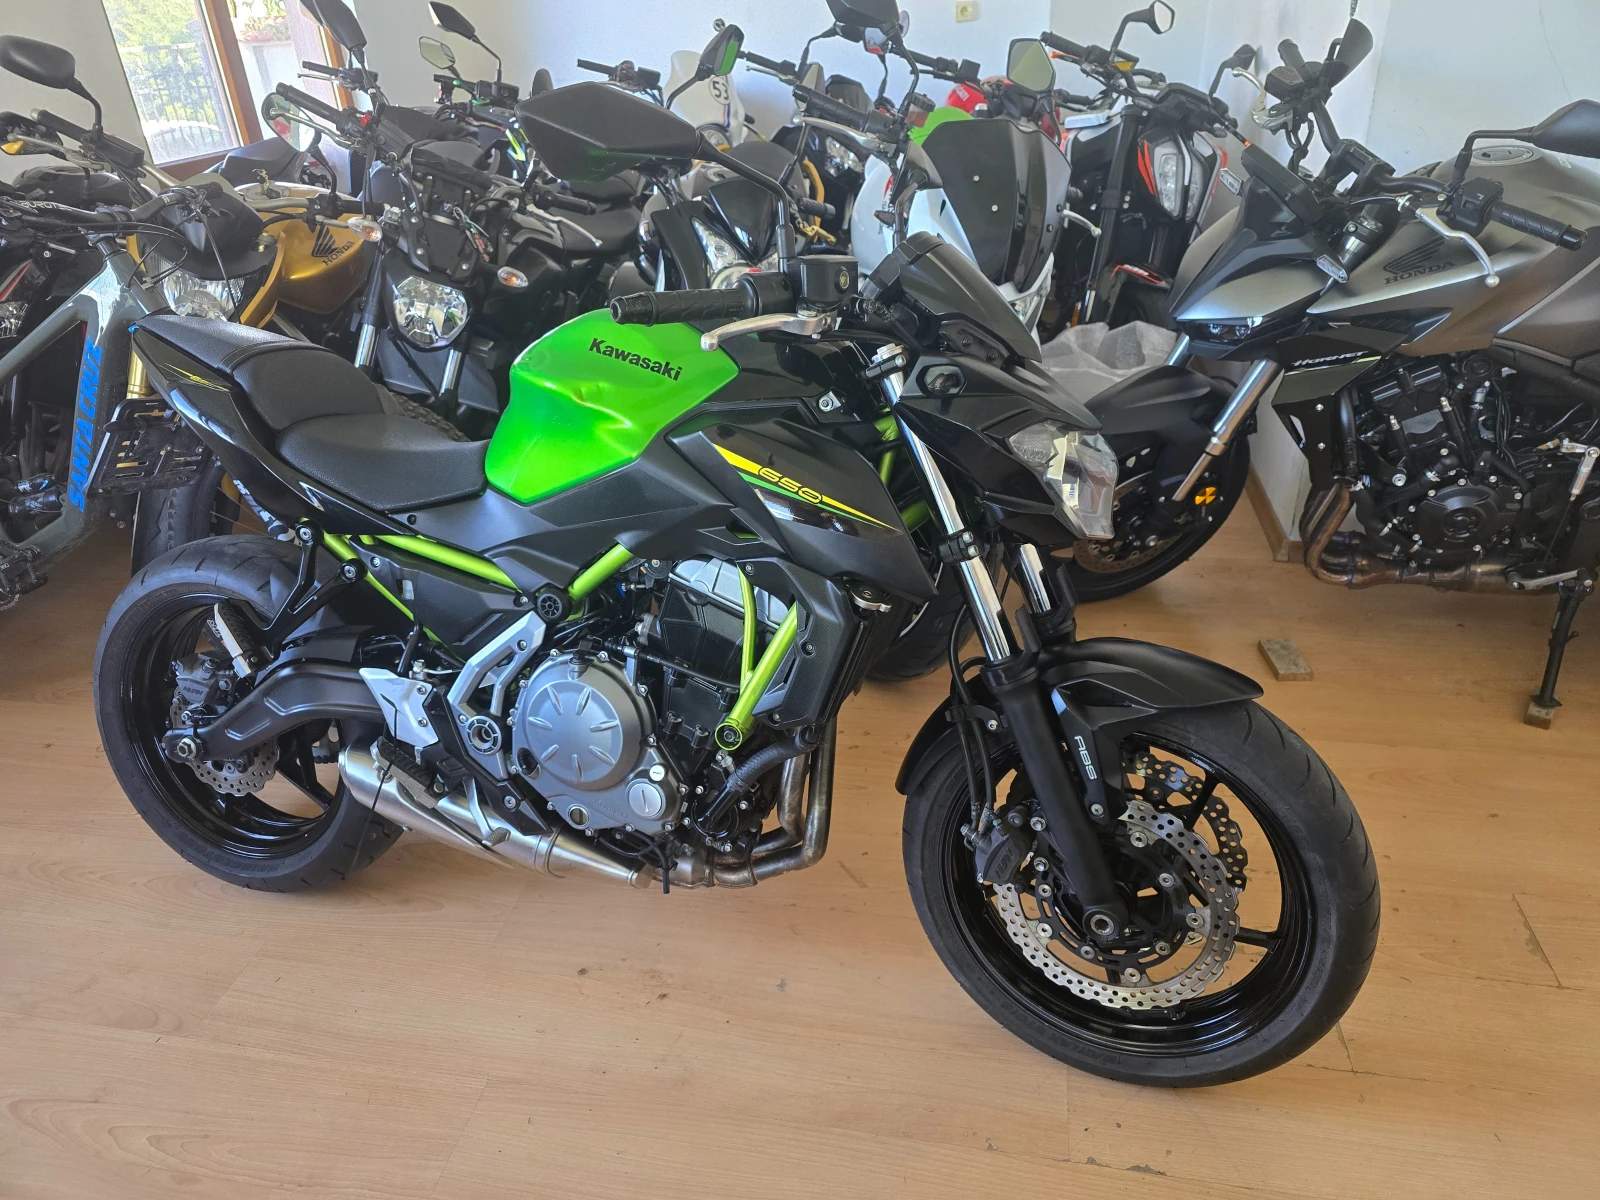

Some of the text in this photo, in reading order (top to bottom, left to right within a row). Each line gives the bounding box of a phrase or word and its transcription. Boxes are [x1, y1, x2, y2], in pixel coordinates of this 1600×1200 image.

[712, 80, 730, 101] 53
[321, 241, 355, 267] HONDA
[1384, 261, 1456, 285] HONDA
[588, 337, 683, 382] Kawasaki
[69, 335, 103, 513] SANTA CRUZ
[759, 467, 823, 504] 650
[1074, 735, 1098, 780] ABS
